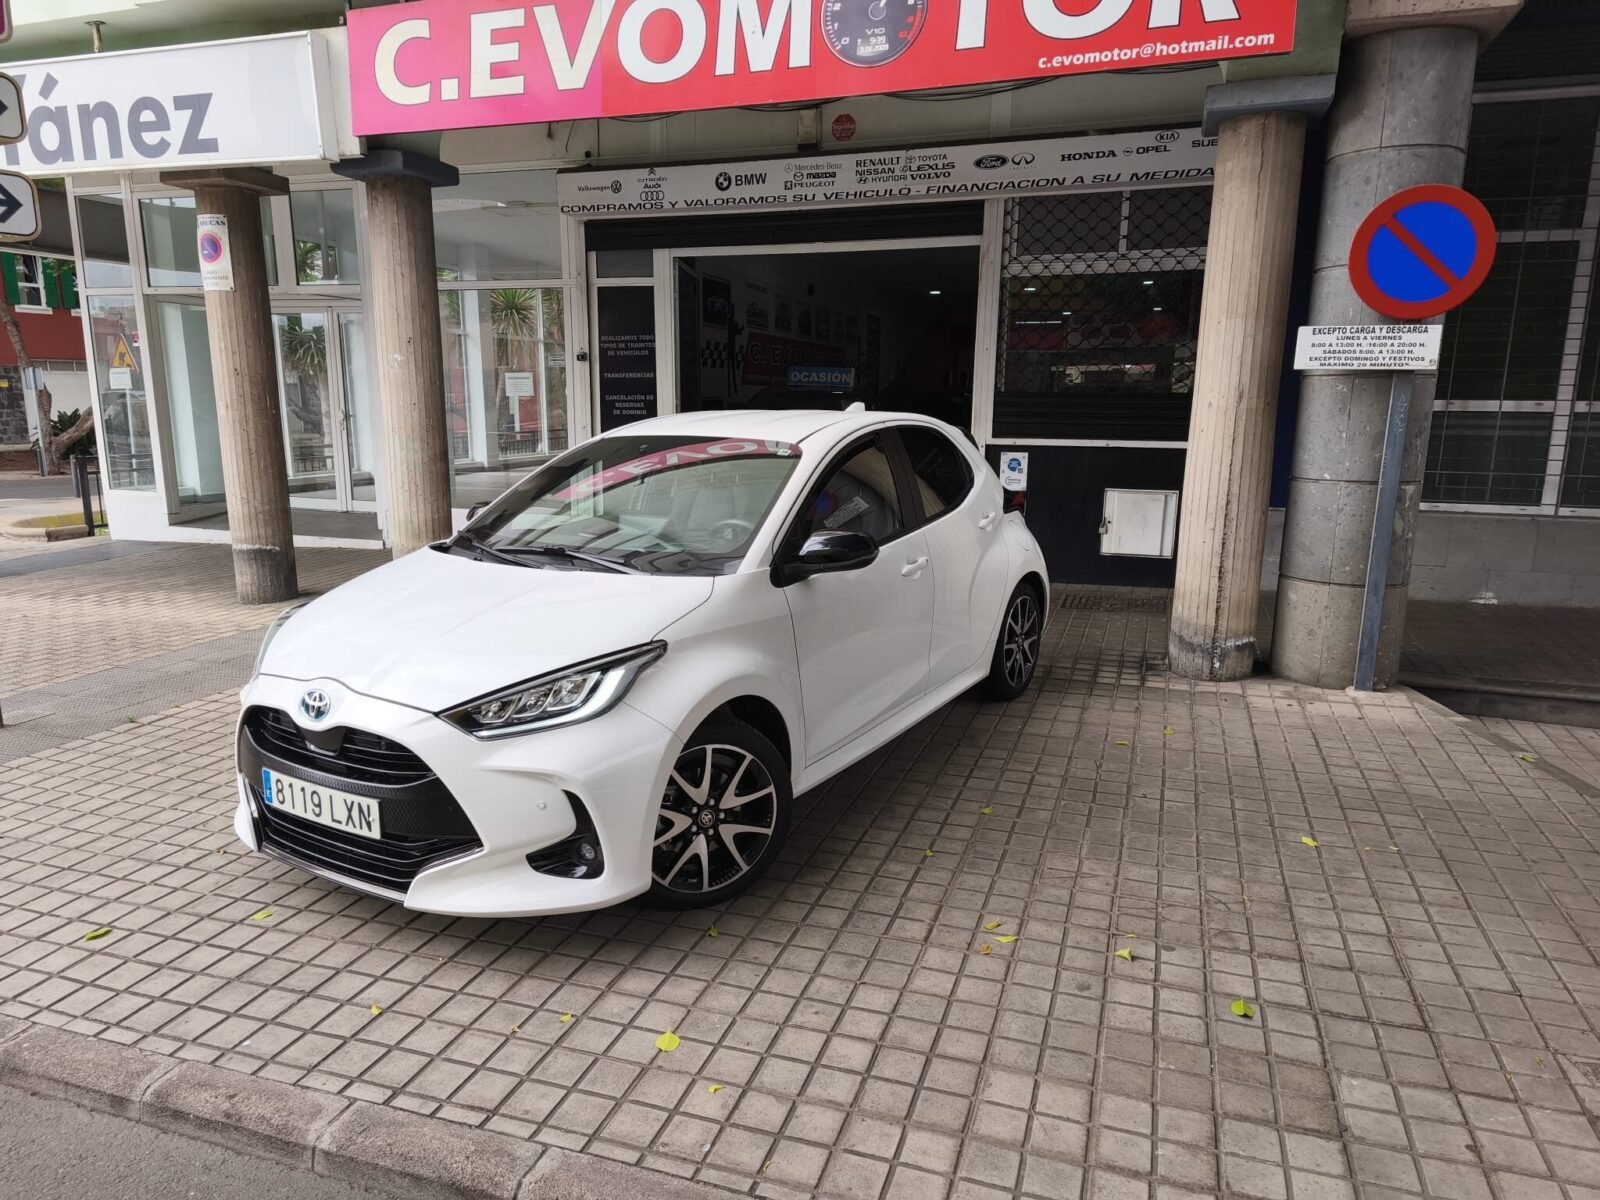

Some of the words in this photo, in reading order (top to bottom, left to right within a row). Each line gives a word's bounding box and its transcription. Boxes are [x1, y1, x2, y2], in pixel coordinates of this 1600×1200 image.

[865, 27, 886, 36] V10
[1038, 31, 1276, 69] c.evomotor@hotmail.com
[1157, 131, 1177, 142] KIA
[1060, 149, 1117, 162] HONDA
[1135, 144, 1172, 155] OPEL
[794, 161, 843, 171] Mercedes-Benz
[855, 156, 901, 168] RENAULT
[917, 153, 948, 162] TOYOTA
[855, 167, 895, 176] NISSAN
[909, 162, 956, 173] LEXUS
[735, 172, 767, 187] BMW
[871, 174, 908, 183] HYUNDAI
[910, 171, 951, 181] VOLVO
[561, 201, 664, 214] COMPRAMOS
[670, 201, 679, 209] Y
[684, 195, 788, 208] VALORAMOS
[792, 193, 816, 202] SU
[823, 186, 912, 200] VEHICULO
[926, 177, 1066, 195] FINANCIACION
[1071, 175, 1085, 185] A
[1091, 173, 1121, 184] SU
[1129, 167, 1215, 182] MEDIDA
[577, 184, 611, 193] Volkswagen
[643, 182, 661, 190] Audi
[794, 180, 835, 189] PEUGEOT
[1312, 327, 1348, 336] EXCEPTO
[1349, 326, 1376, 335] CARGA
[1379, 326, 1384, 334] Y
[1386, 325, 1429, 334] DESCARGA
[275, 777, 323, 818] 8119
[329, 794, 373, 832] LXN
